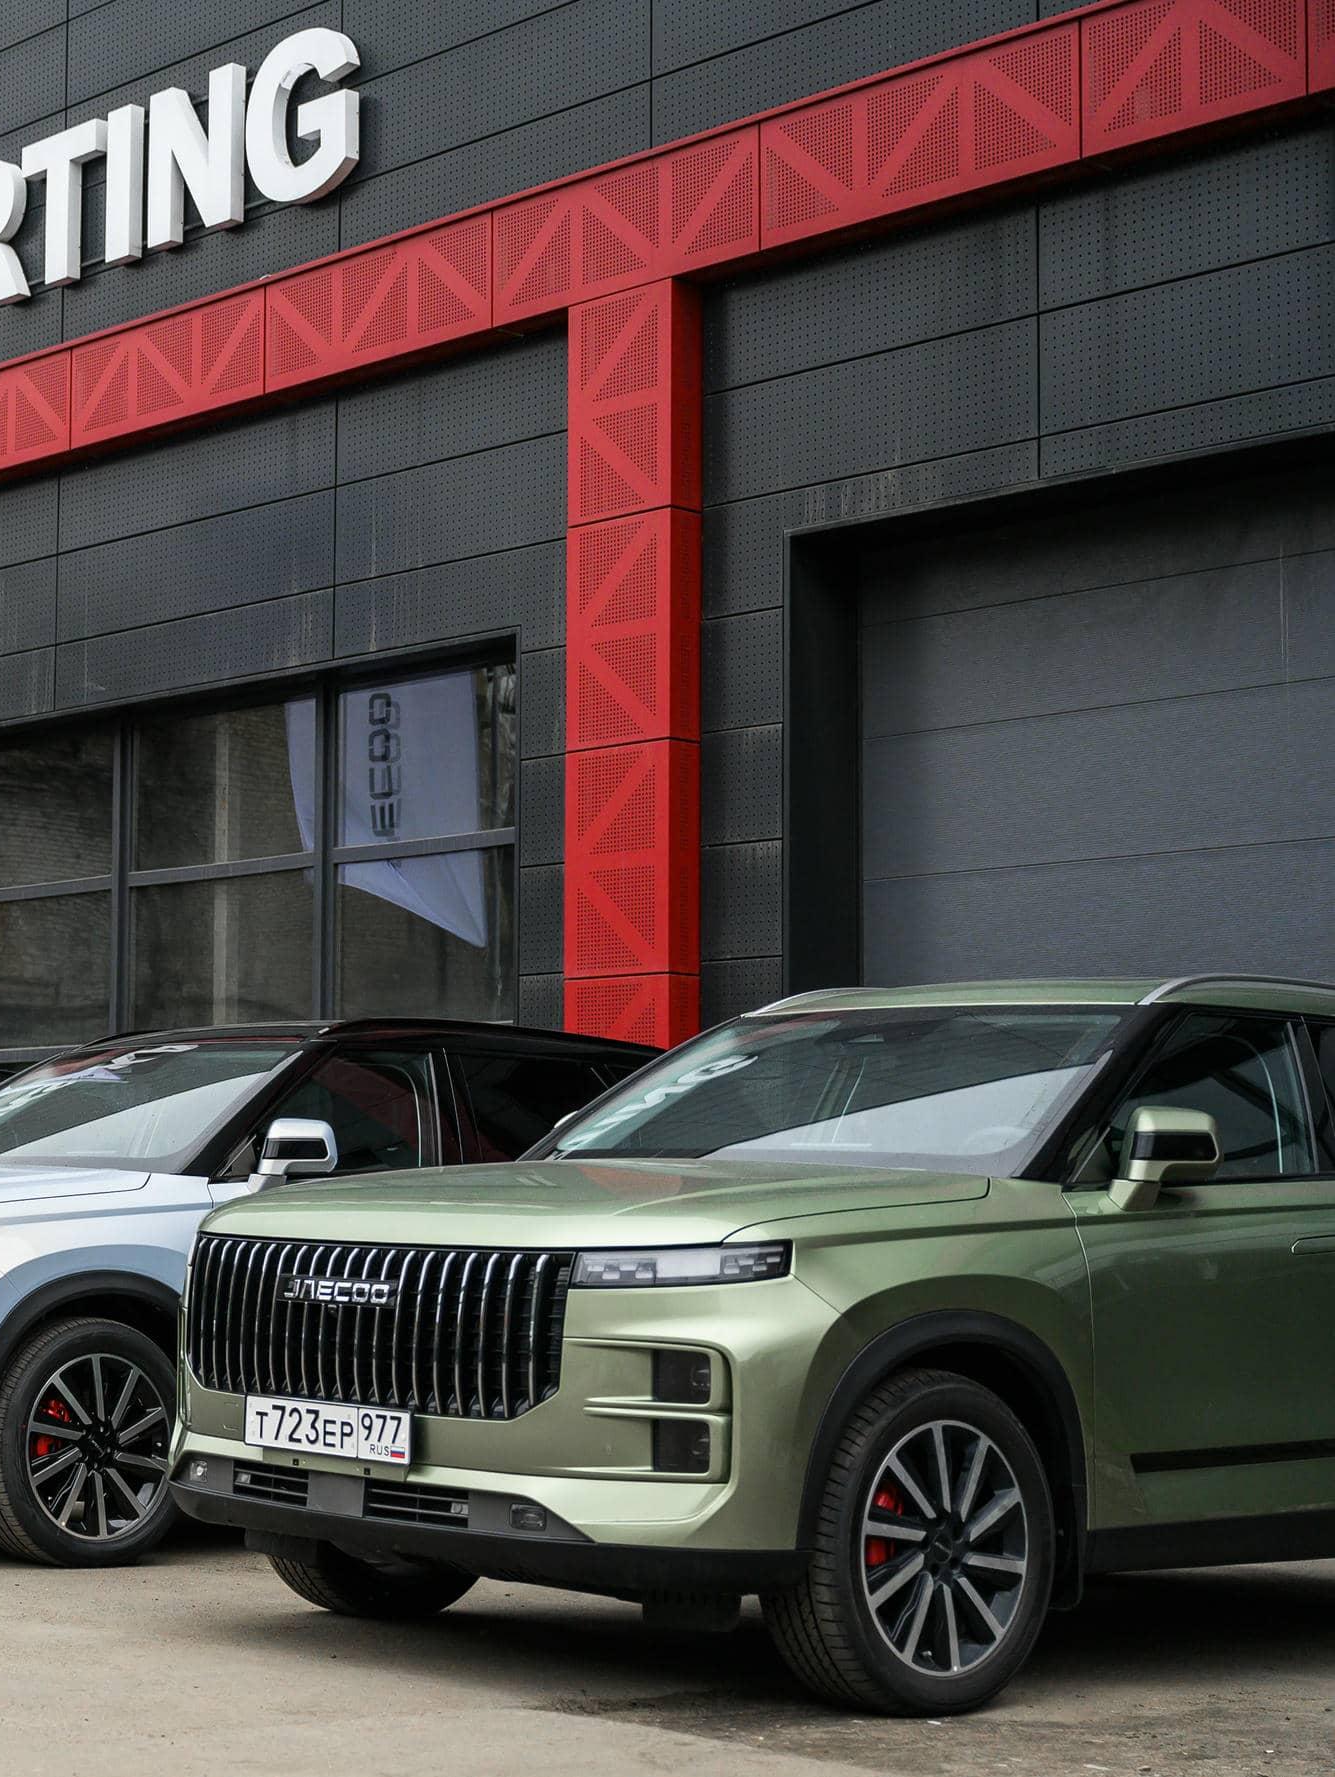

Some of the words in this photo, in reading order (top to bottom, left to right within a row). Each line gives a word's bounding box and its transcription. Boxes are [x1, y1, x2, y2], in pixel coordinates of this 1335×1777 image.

[284, 1279, 390, 1303] JAECOO
[361, 1413, 402, 1444] 977
[370, 1444, 390, 1456] RUS
